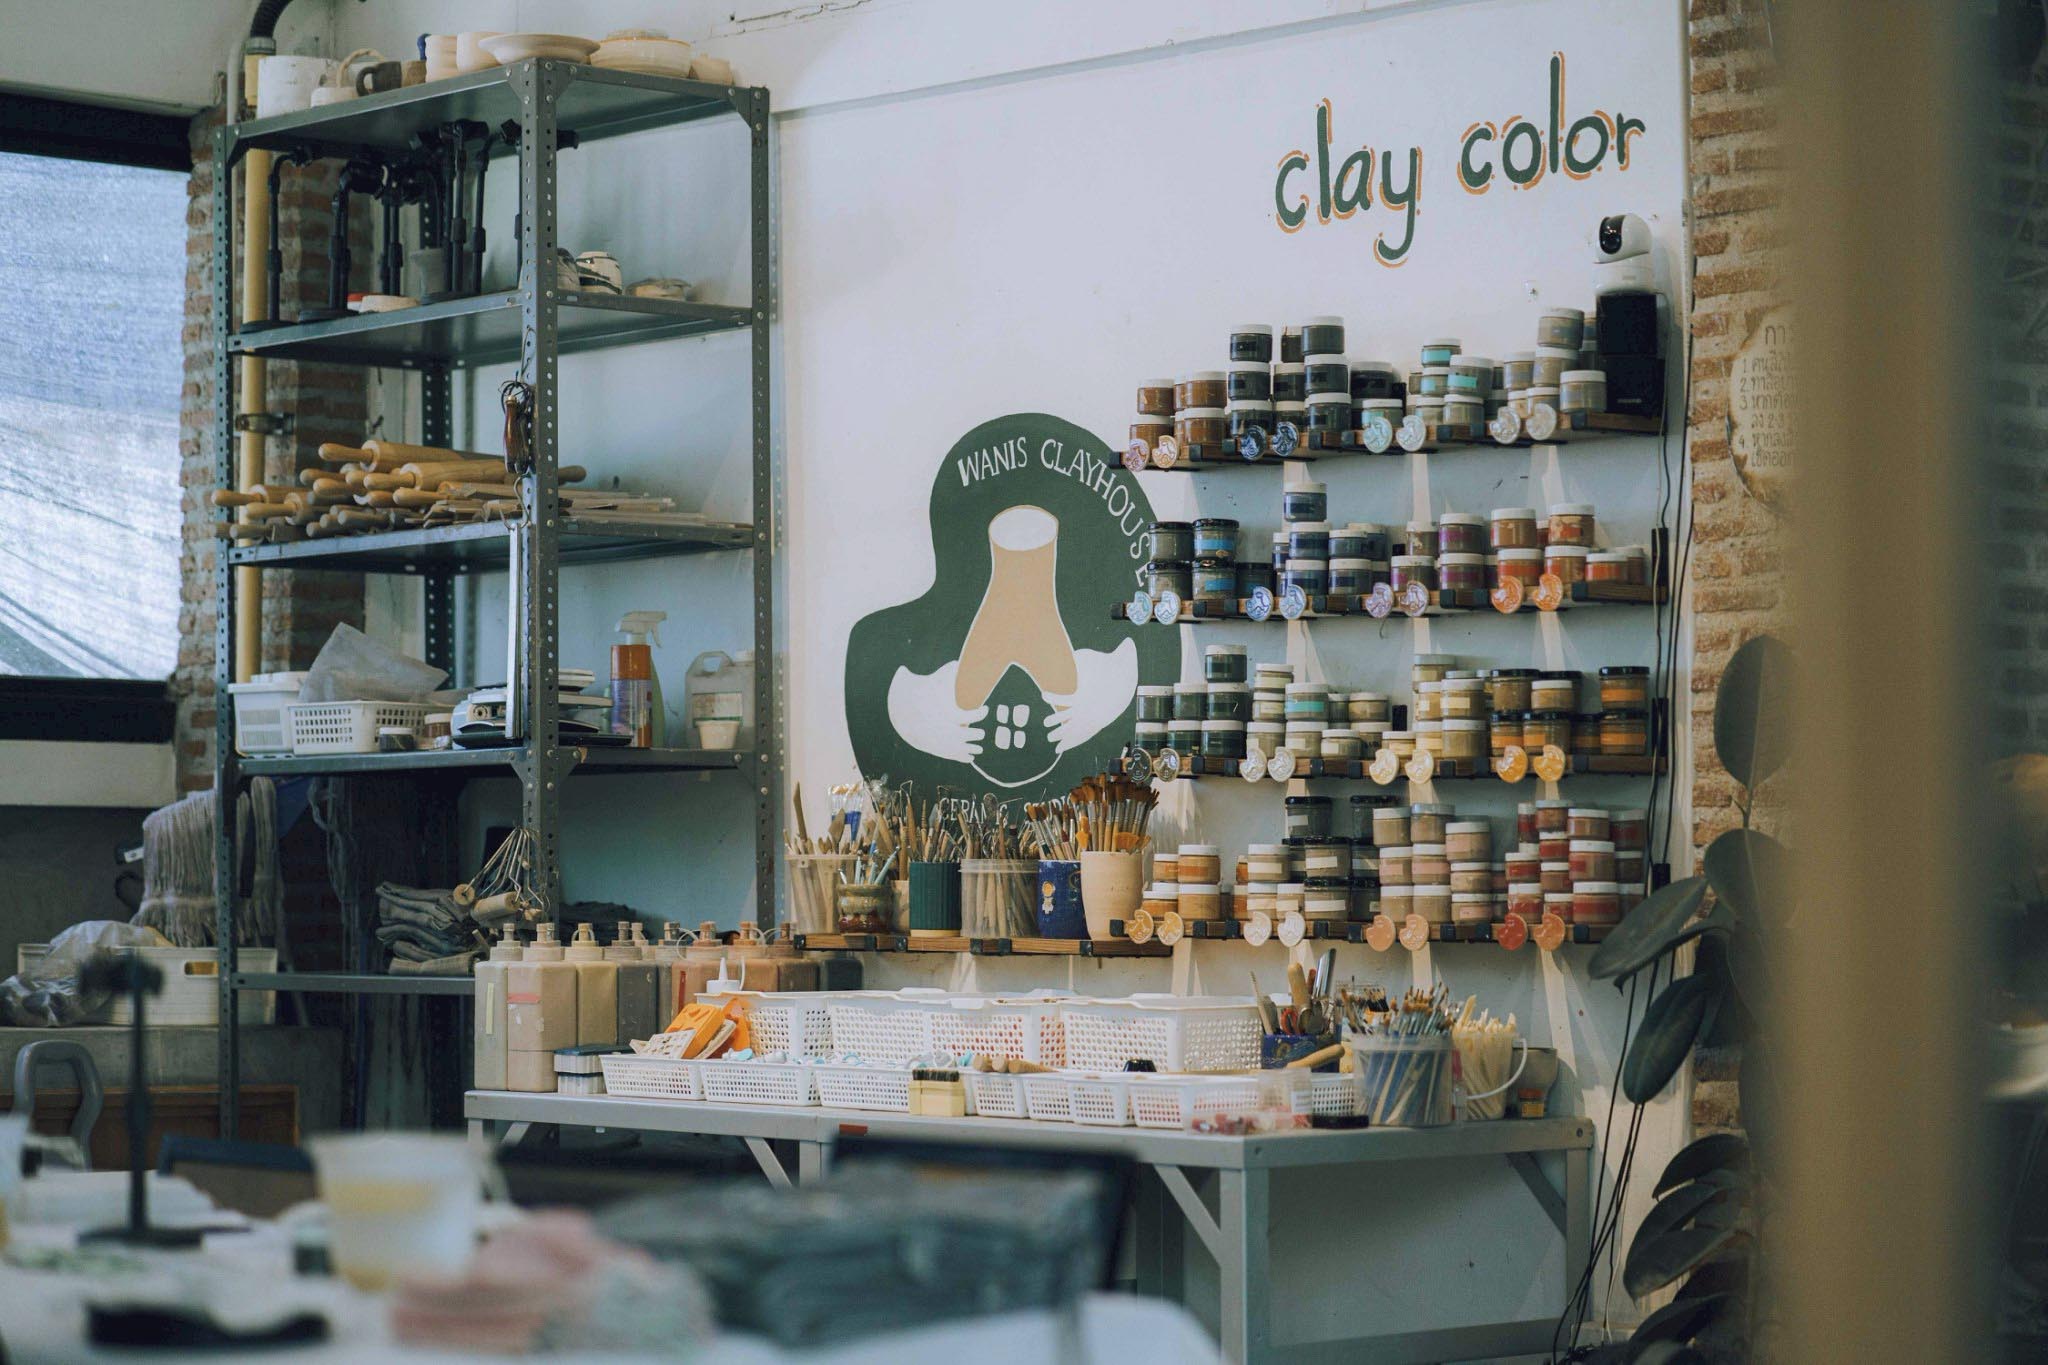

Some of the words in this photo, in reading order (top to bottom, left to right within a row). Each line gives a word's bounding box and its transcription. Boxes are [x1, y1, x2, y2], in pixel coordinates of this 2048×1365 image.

[1275, 98, 1423, 268] clay
[1457, 51, 1646, 195] color
[957, 436, 1028, 487] WANIS
[1040, 438, 1150, 588] CLAYHOUSE
